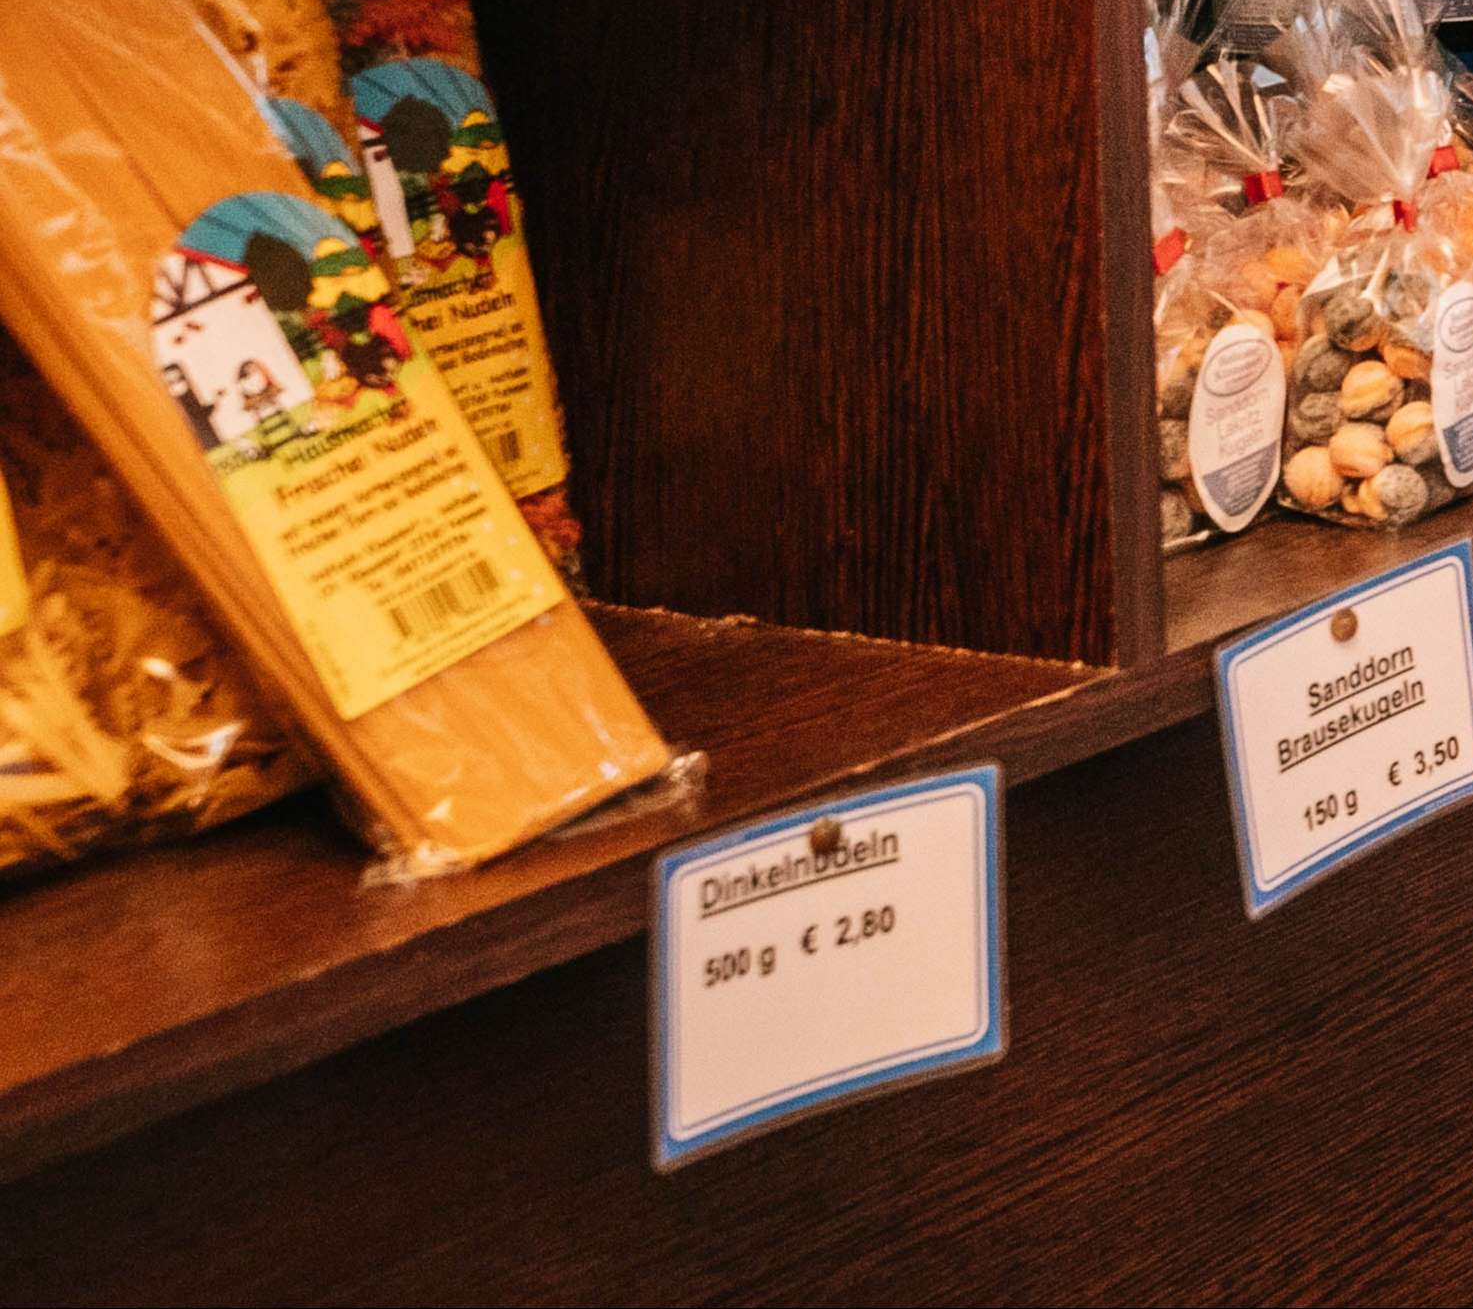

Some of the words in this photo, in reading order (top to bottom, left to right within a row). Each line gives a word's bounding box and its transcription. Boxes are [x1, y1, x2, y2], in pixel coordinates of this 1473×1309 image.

[1307, 642, 1416, 710] Sanddorn
[1276, 677, 1427, 772] Brausekugeln
[1304, 792, 1342, 832] 150
[1344, 786, 1360, 819] g
[1388, 761, 1403, 789] €
[1413, 734, 1461, 779] 3,50
[700, 829, 900, 911] Dinkelnudeln
